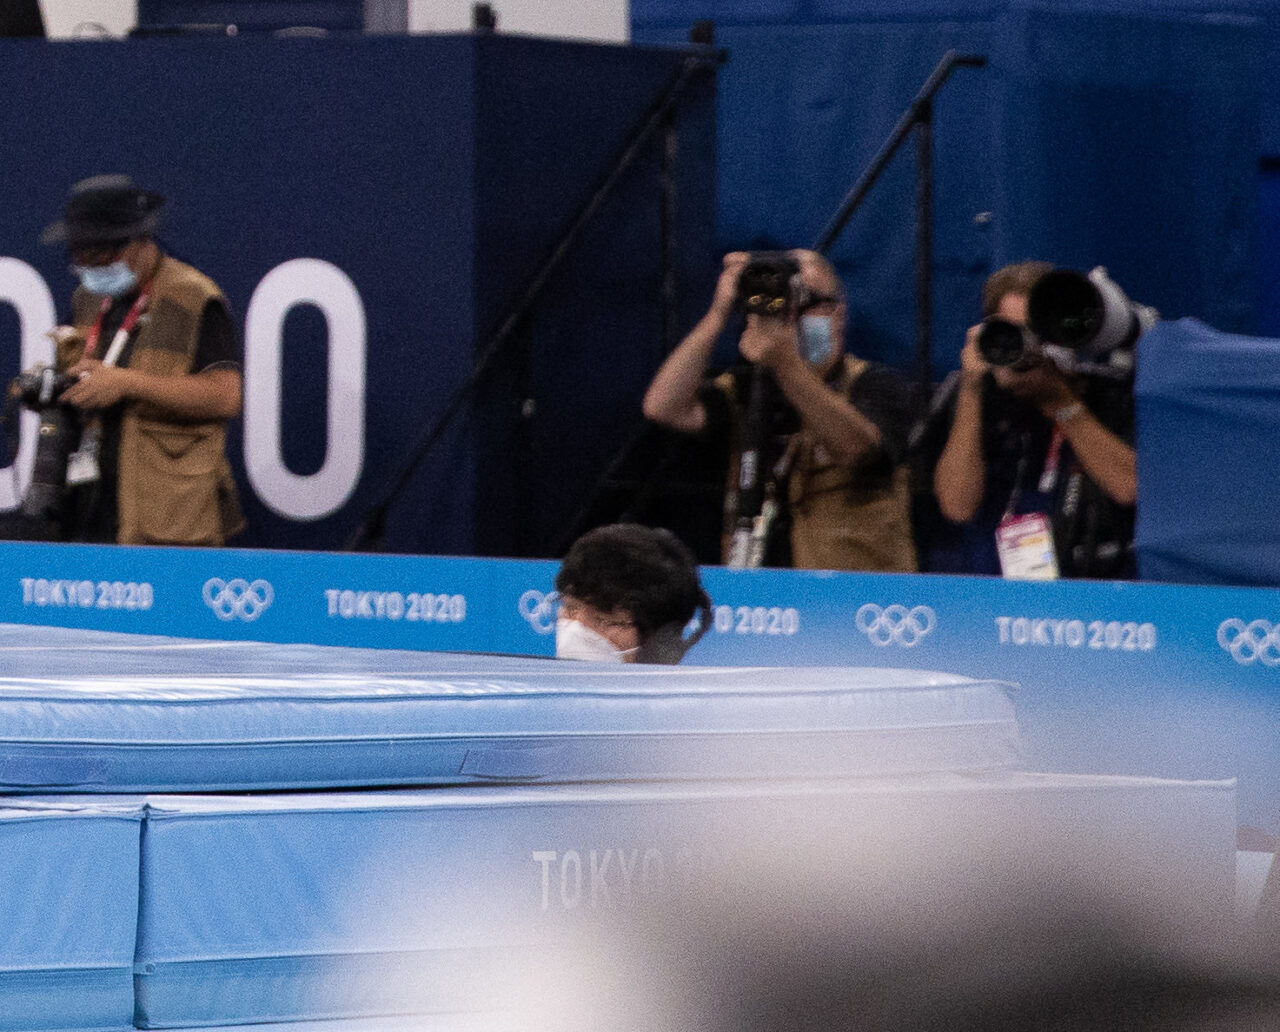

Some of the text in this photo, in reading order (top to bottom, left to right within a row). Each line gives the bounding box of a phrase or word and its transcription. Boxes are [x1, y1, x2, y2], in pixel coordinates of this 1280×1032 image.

[21, 578, 153, 609] TOKYO 2020
[325, 589, 466, 622] TOKYO 2020
[735, 606, 799, 635] 2020
[995, 616, 1157, 650] TOKYO 2020
